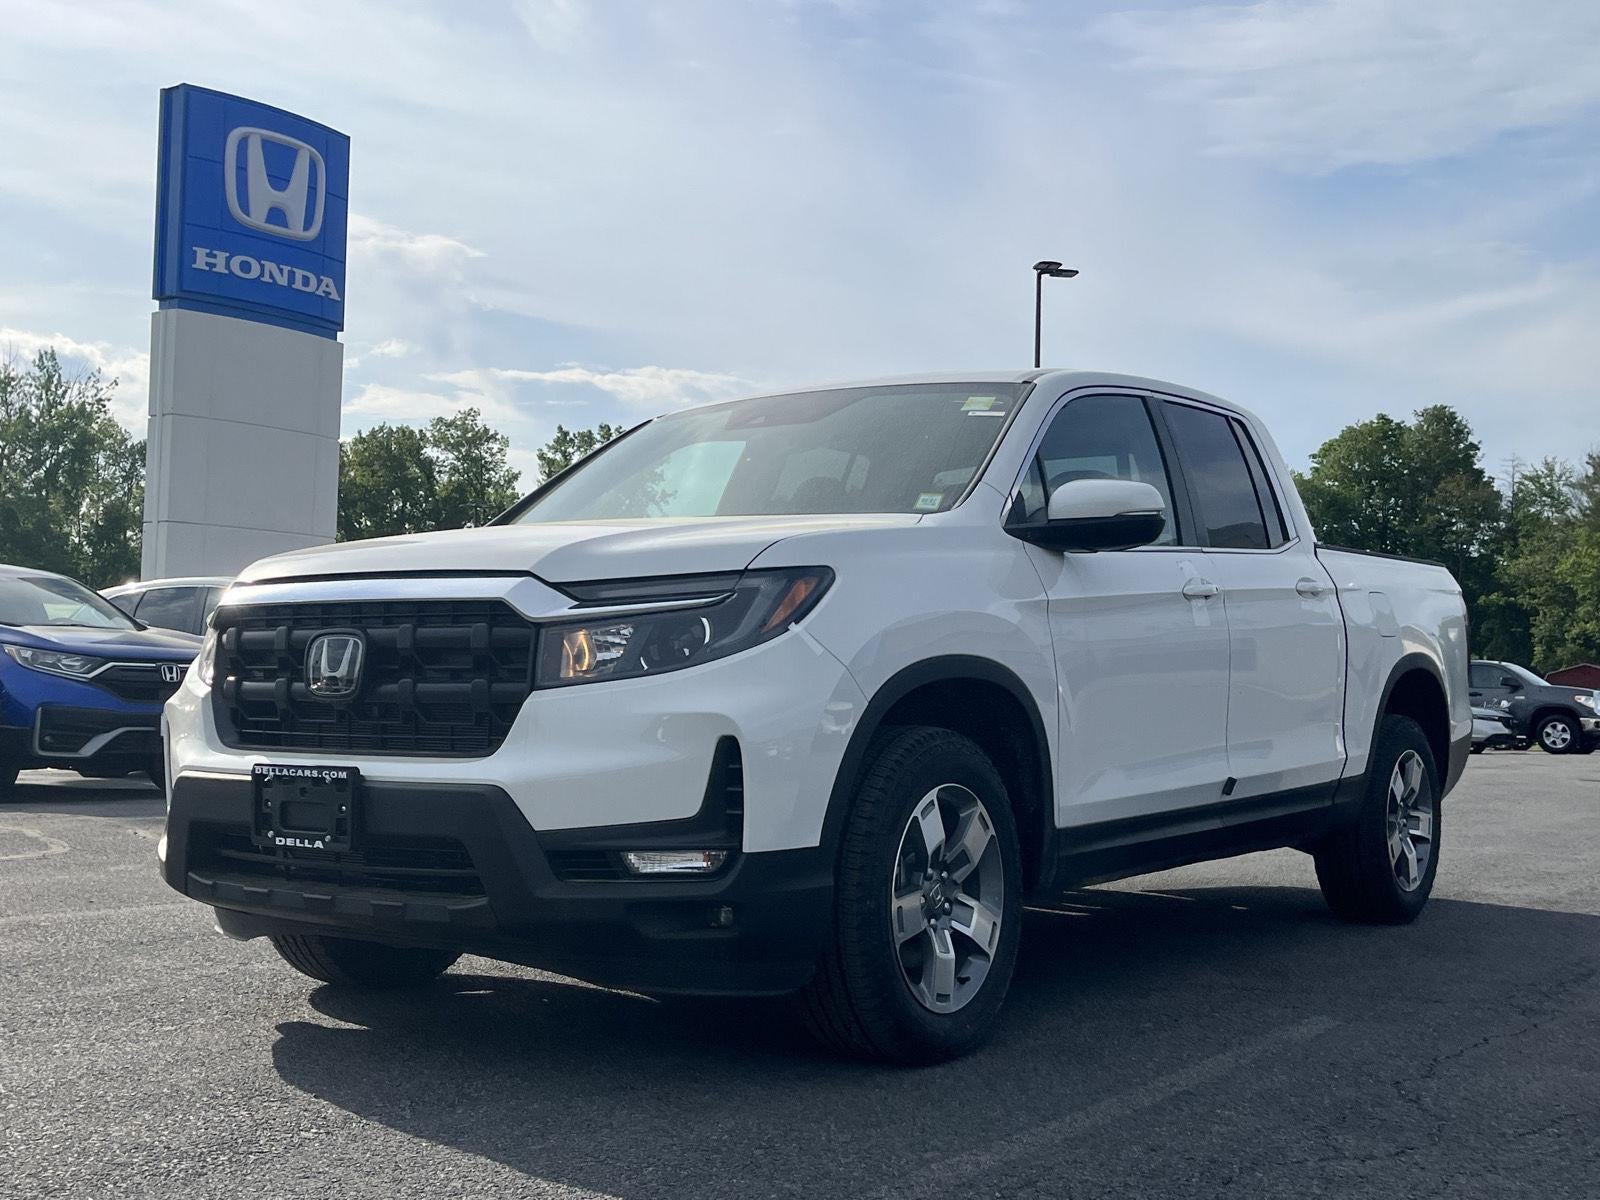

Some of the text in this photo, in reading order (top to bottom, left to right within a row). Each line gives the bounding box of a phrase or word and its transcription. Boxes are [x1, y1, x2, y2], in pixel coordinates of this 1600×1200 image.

[191, 246, 341, 301] HONDA
[254, 767, 347, 779] DELLACARS.COM
[275, 837, 324, 849] DELLA
